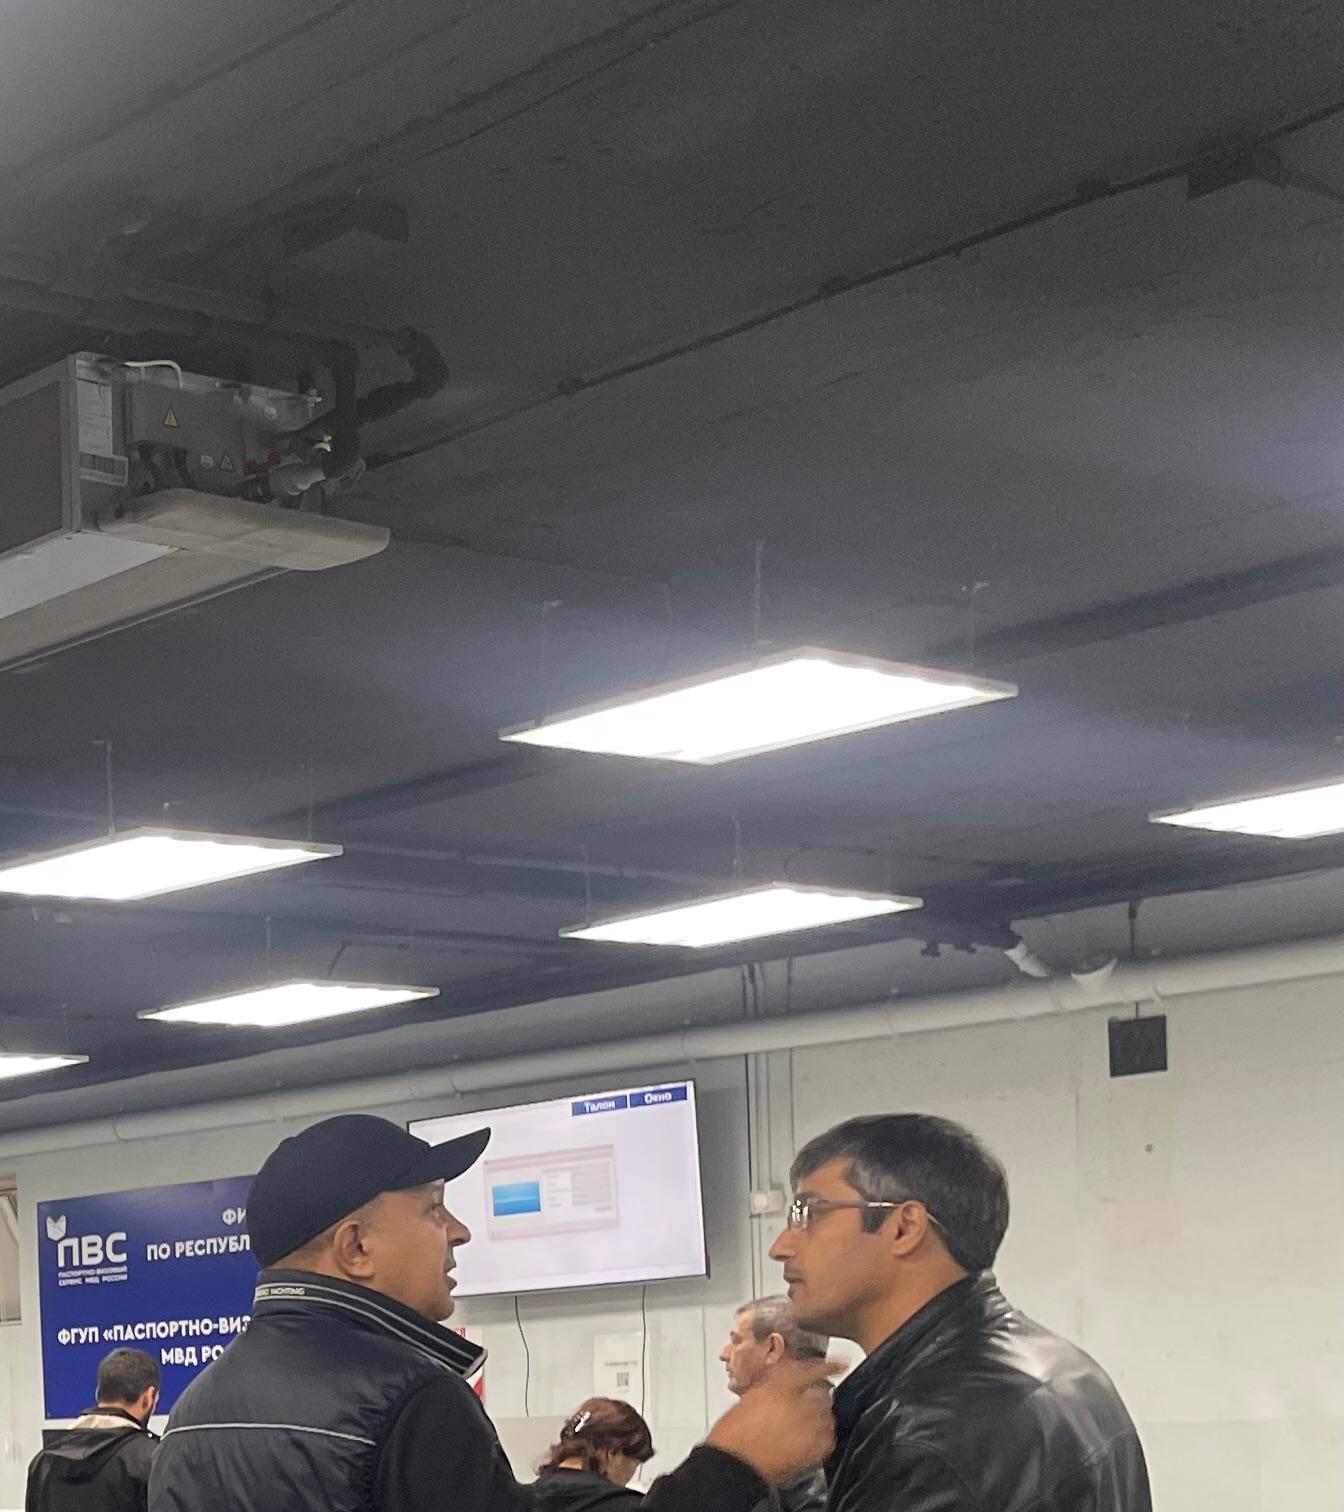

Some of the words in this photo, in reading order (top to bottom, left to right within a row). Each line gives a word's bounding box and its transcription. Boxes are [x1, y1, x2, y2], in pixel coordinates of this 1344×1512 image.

[222, 1207, 246, 1225] ФИ
[58, 1231, 127, 1268] ПВС
[146, 1243, 171, 1261] ПО
[175, 1234, 250, 1258] РЕСПУБЛ
[57, 1326, 99, 1345] ФГУП
[103, 1315, 251, 1342] «ПАСПОРТНО-ВИЗ
[161, 1347, 197, 1367] МВД
[202, 1345, 224, 1363] РО
